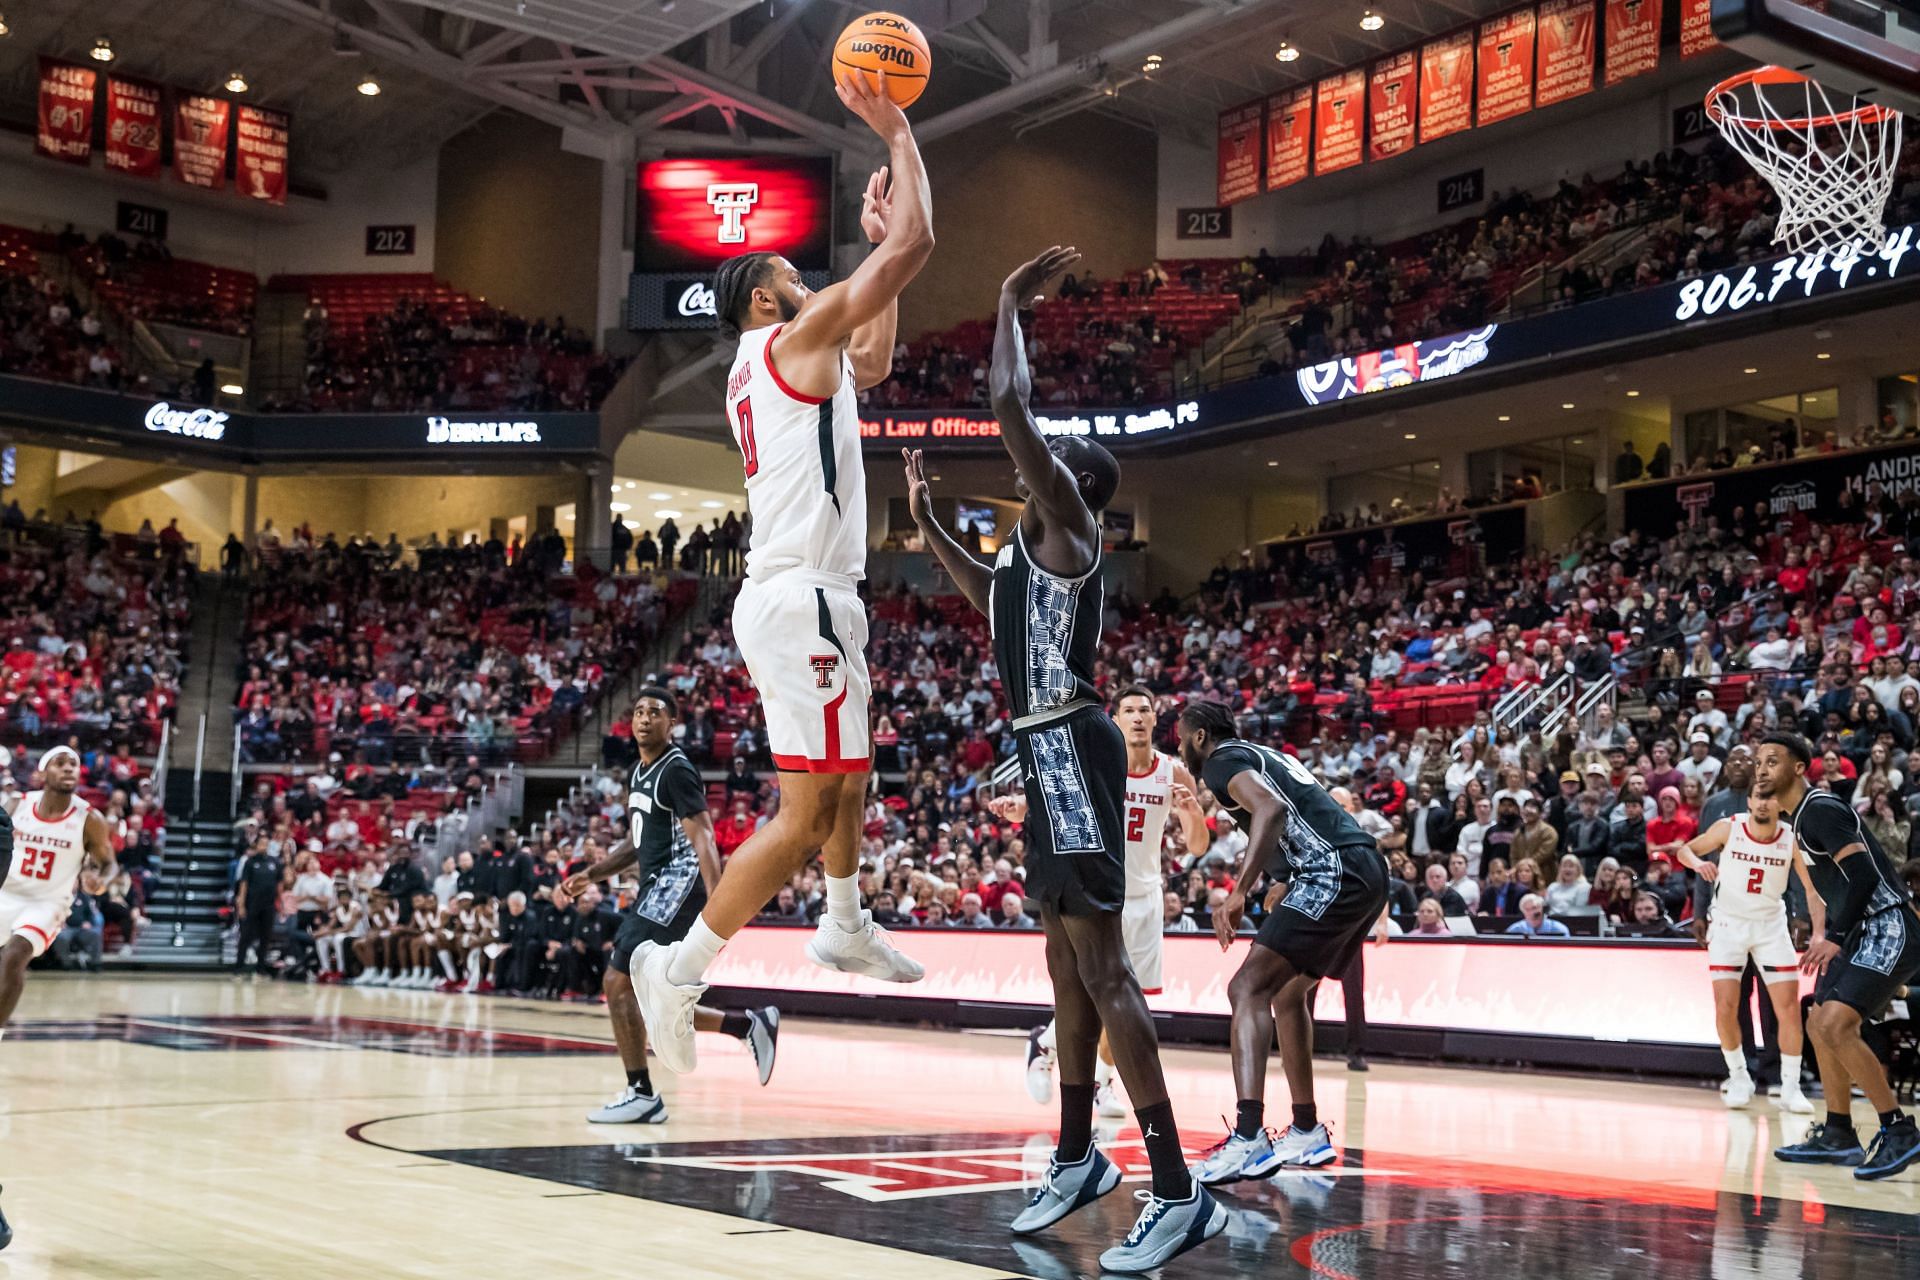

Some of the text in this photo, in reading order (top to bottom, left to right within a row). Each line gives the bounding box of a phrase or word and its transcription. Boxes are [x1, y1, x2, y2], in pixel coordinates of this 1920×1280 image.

[865, 18, 910, 33] NCAA
[852, 42, 915, 68] Wilson
[1545, 55, 1585, 76] BORDER
[1485, 75, 1523, 96] BORDER
[1538, 64, 1592, 90] CONFERENCE
[1479, 84, 1531, 110] CONFERENCE
[1540, 79, 1590, 103] CHAMPIONS
[50, 104, 84, 134] #1
[111, 118, 160, 151] #22
[1446, 183, 1476, 205] 214
[129, 209, 156, 232] 211
[1187, 213, 1222, 235] 213
[375, 231, 407, 251] 212
[1676, 226, 1920, 321] 806.744.4
[858, 419, 881, 437] he
[885, 418, 927, 437] Law
[931, 417, 1001, 437] Offices
[1094, 415, 1121, 435] W.
[1177, 401, 1199, 424] PC
[737, 395, 759, 479] 0
[1845, 474, 1863, 493] 14
[1139, 793, 1164, 806] TECH
[1127, 807, 1146, 843] 2
[47, 837, 72, 849] TECH
[20, 846, 56, 881] 23
[1731, 851, 1761, 864] TEXAS
[1763, 856, 1786, 867] TECH
[1747, 867, 1765, 895] 2
